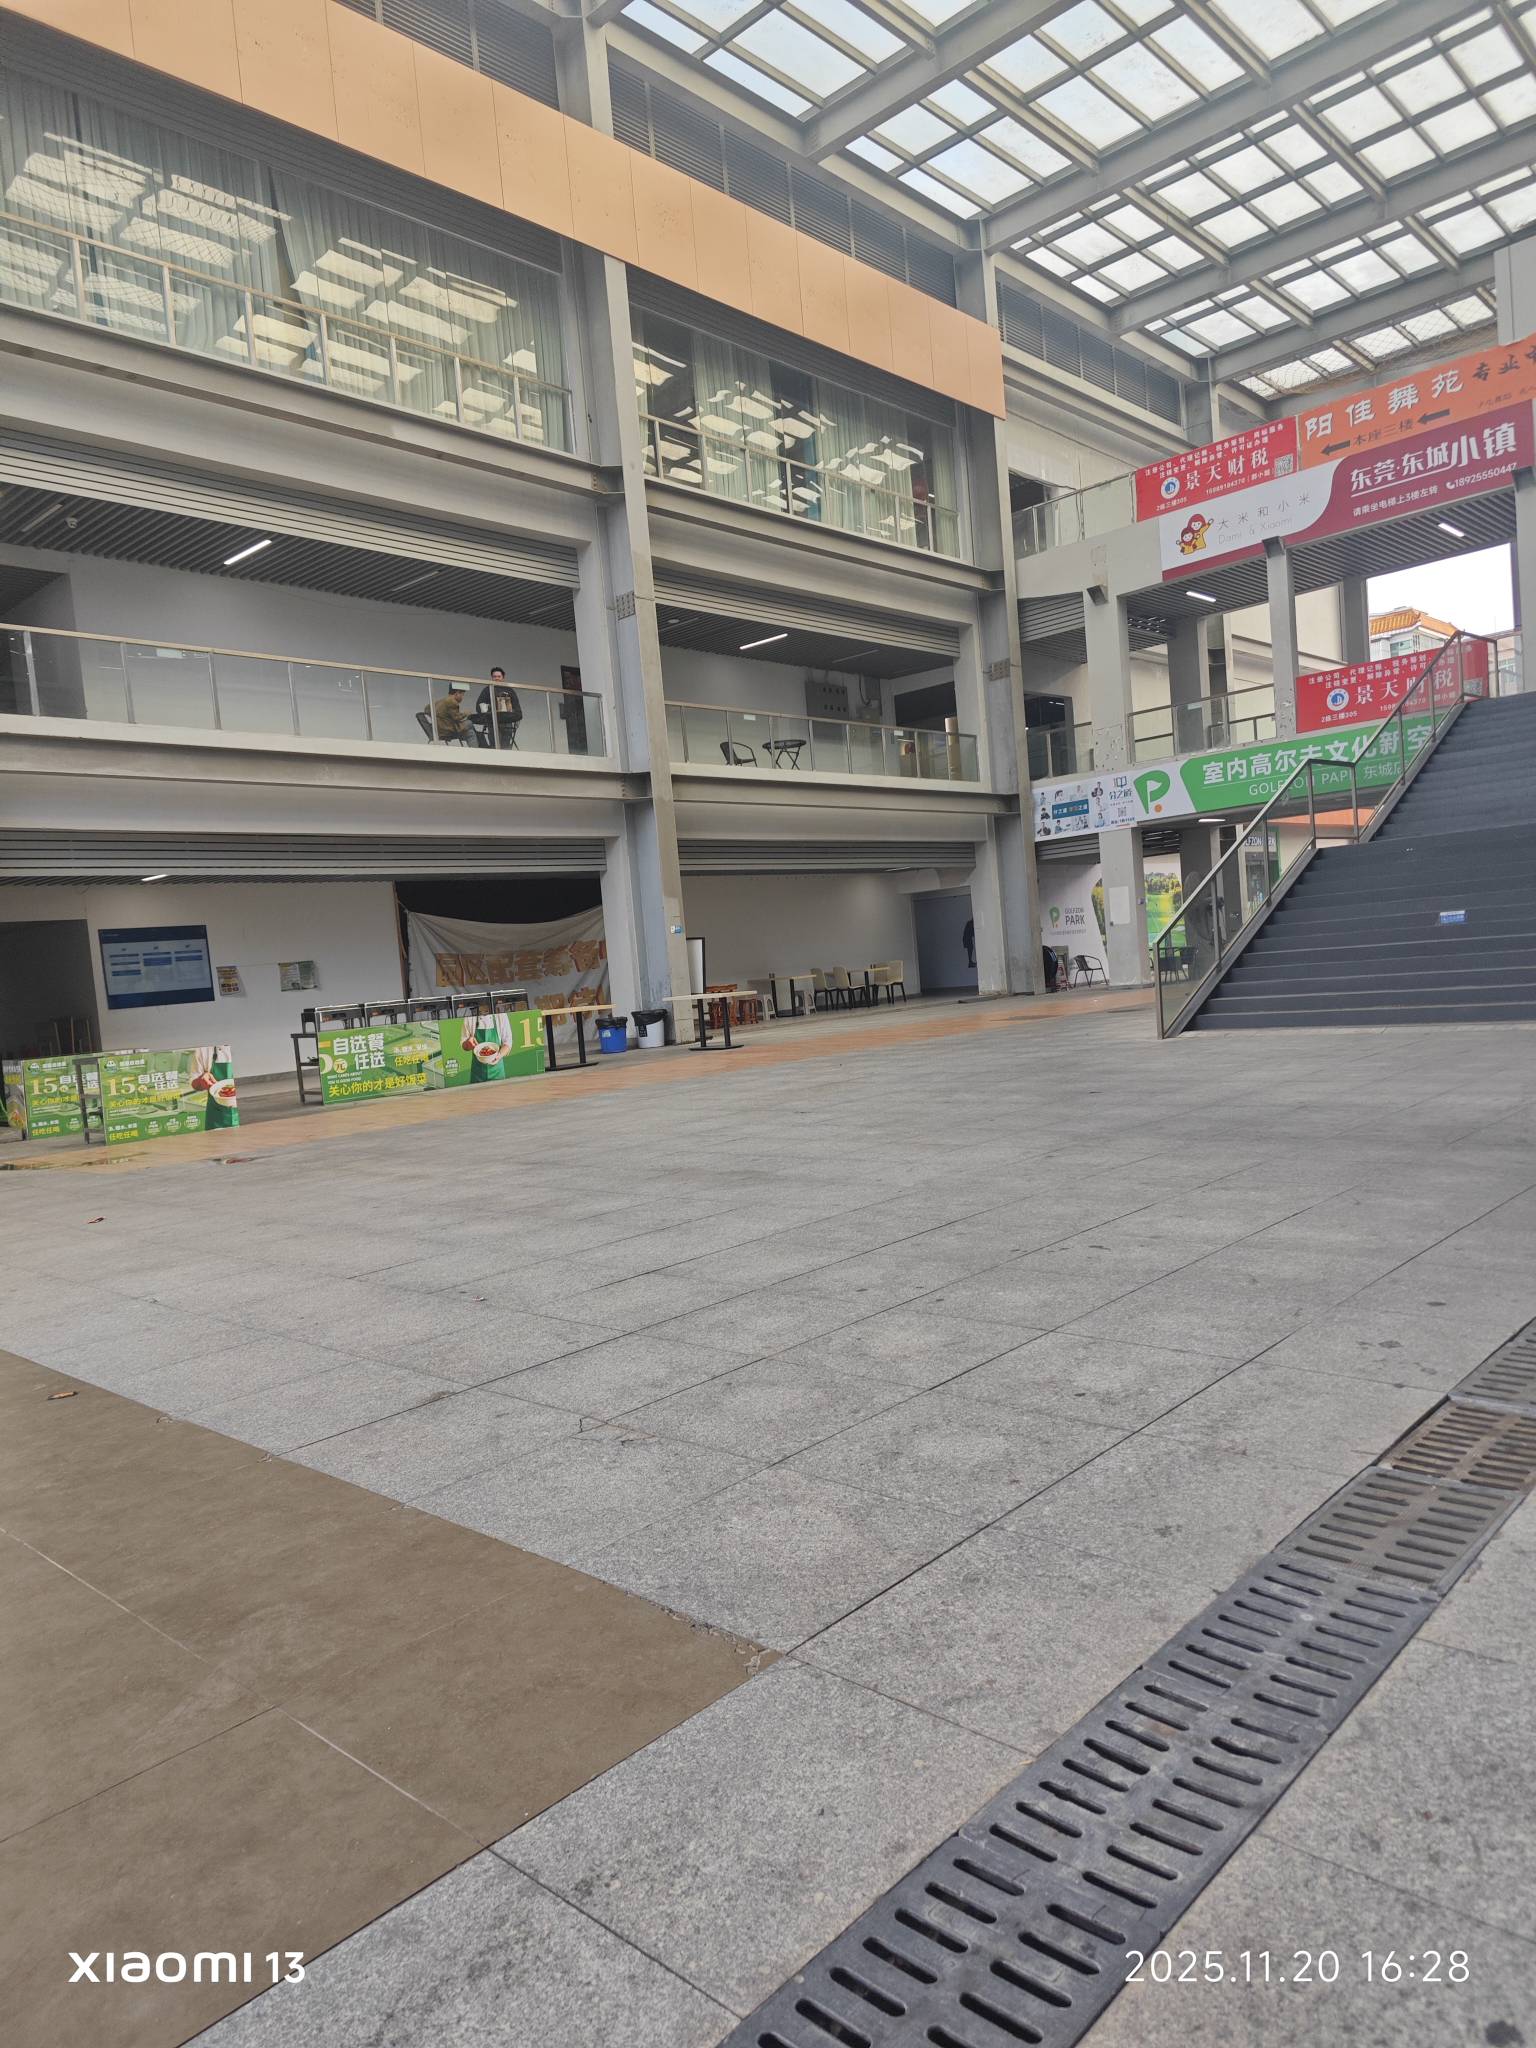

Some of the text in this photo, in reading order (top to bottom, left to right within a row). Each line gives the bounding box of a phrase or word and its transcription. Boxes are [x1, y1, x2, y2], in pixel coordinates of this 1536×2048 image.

[1304, 369, 1464, 441] 阳佳舞苑
[1353, 418, 1414, 447] 本座三楼
[1185, 447, 1269, 491] 景天财税
[1350, 421, 1518, 492] 东莞·东城小镇
[1216, 493, 1311, 531] 大米和小米
[1065, 914, 1086, 926] PARK
[333, 1032, 385, 1056] 自选餐
[355, 1052, 386, 1071] 任选
[32, 1076, 58, 1096] 15
[108, 1075, 136, 1097] 15
[329, 1072, 428, 1098] 关心你的才是好饭菜
